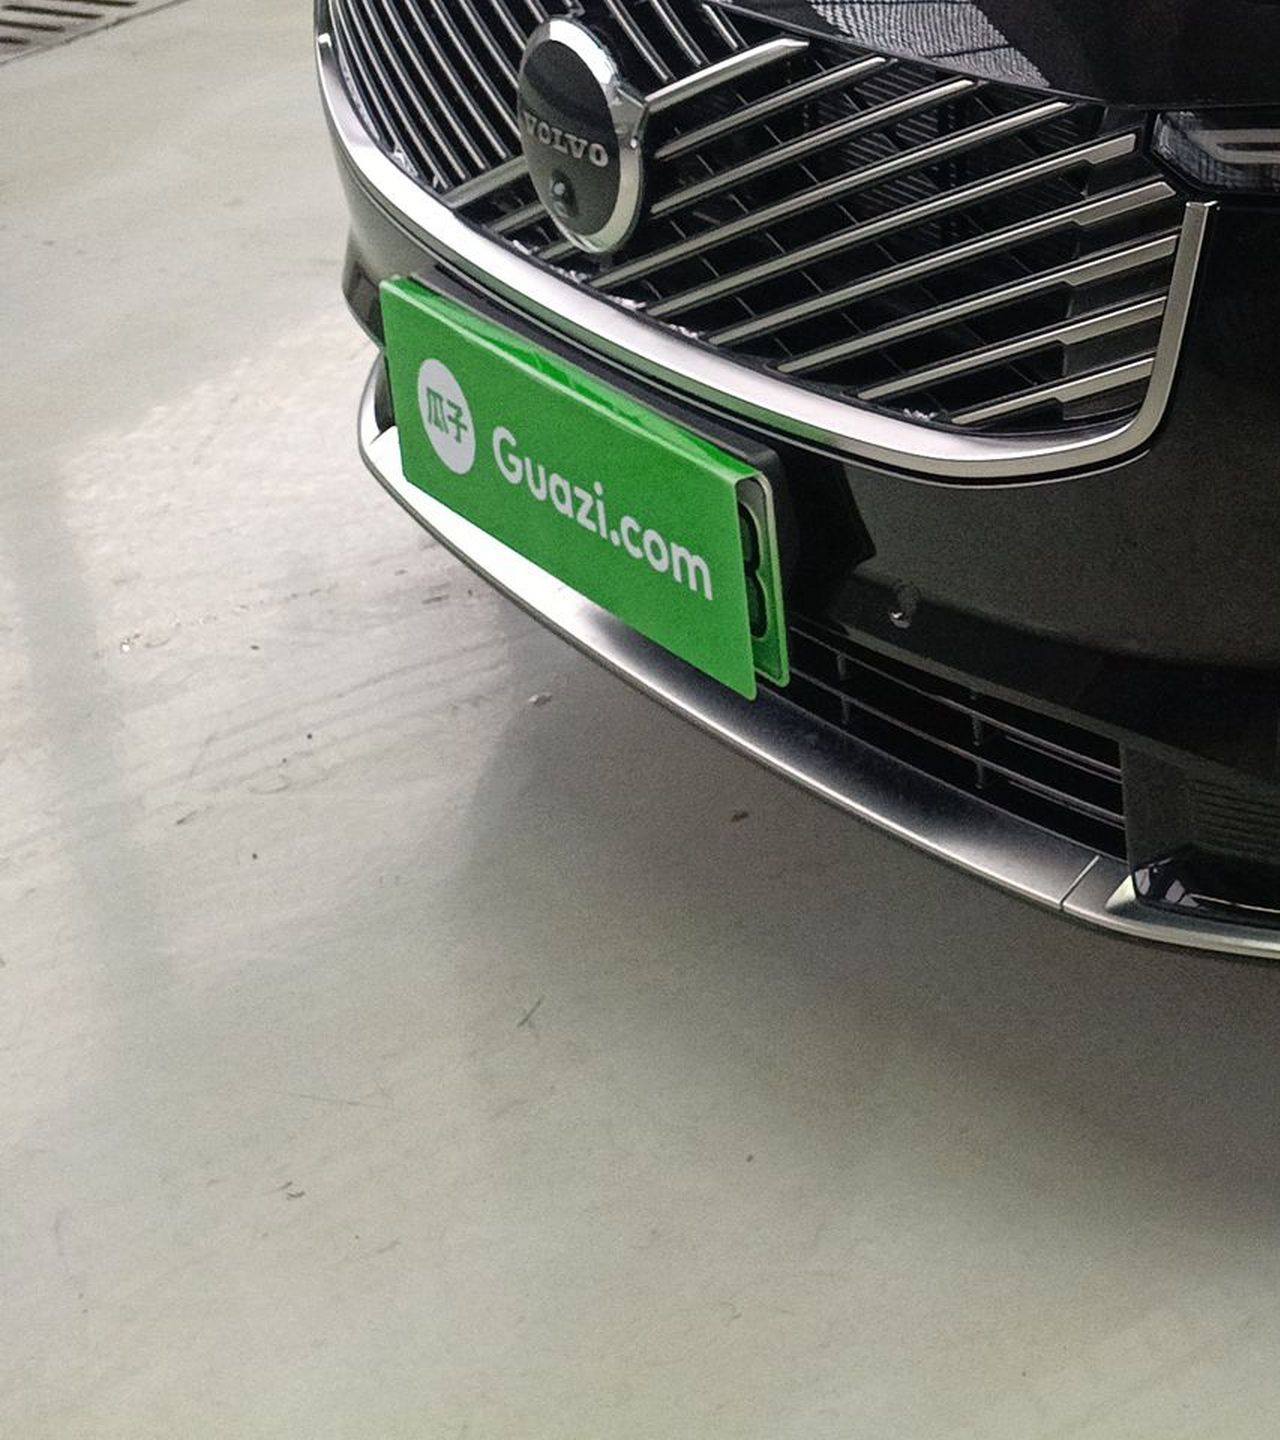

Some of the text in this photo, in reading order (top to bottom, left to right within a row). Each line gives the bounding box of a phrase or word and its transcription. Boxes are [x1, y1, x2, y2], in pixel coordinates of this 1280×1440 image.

[522, 110, 609, 168] VOLVO
[426, 386, 468, 445] 瓜子
[492, 426, 713, 602] Guazi.com
